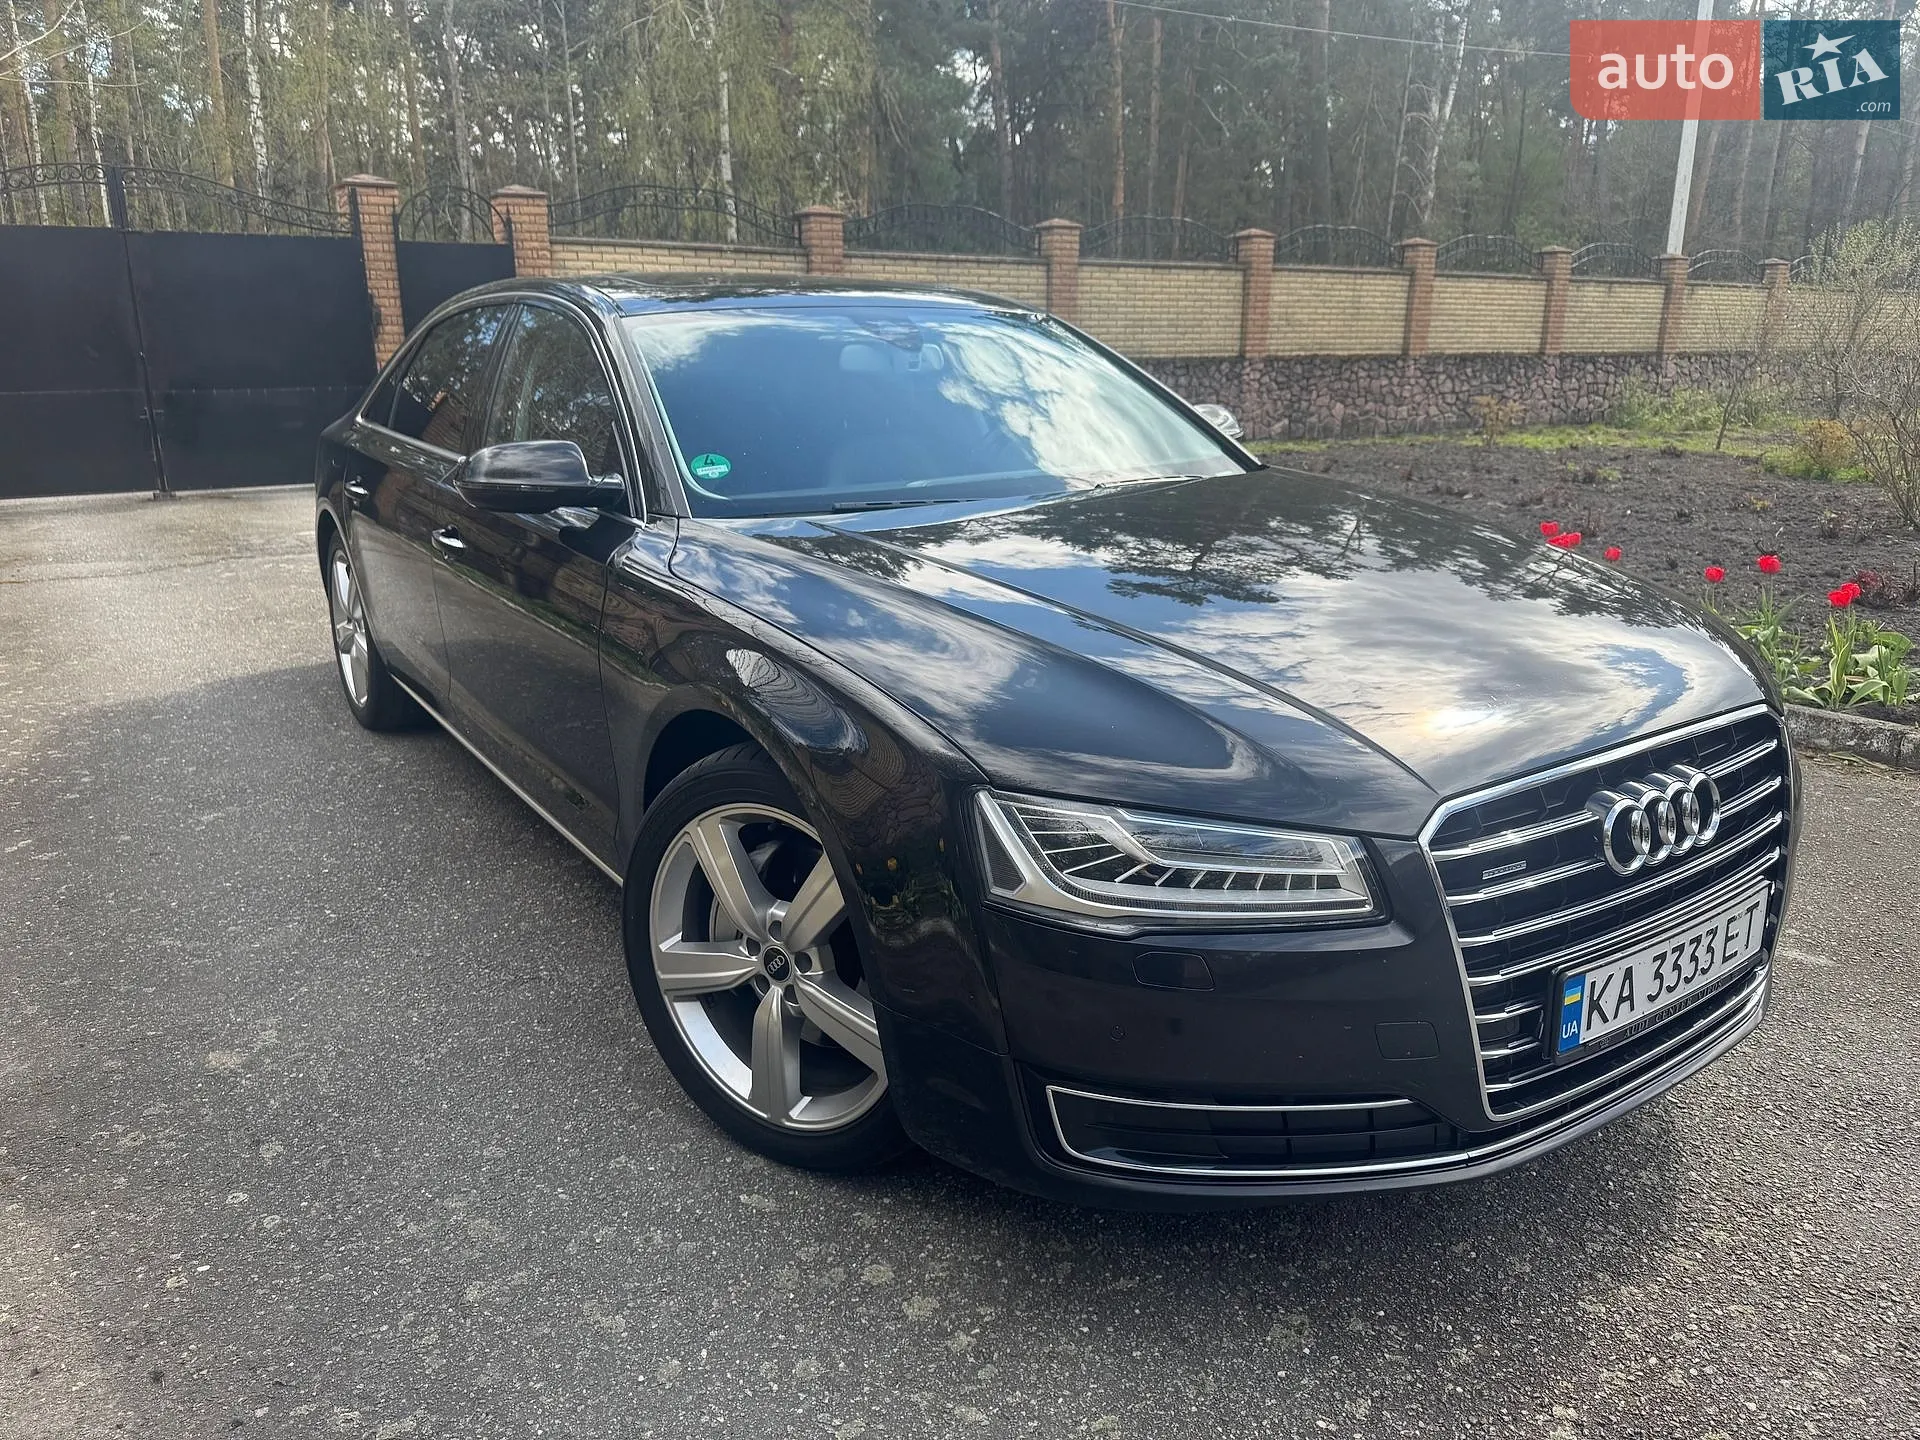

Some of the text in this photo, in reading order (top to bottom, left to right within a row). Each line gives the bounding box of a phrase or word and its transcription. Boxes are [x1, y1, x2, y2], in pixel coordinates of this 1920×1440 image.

[704, 454, 716, 466] 4
[1585, 900, 1761, 1031] KA 3333 ET
[1562, 1022, 1579, 1038] UA
[1624, 1019, 1649, 1039] AUDI
